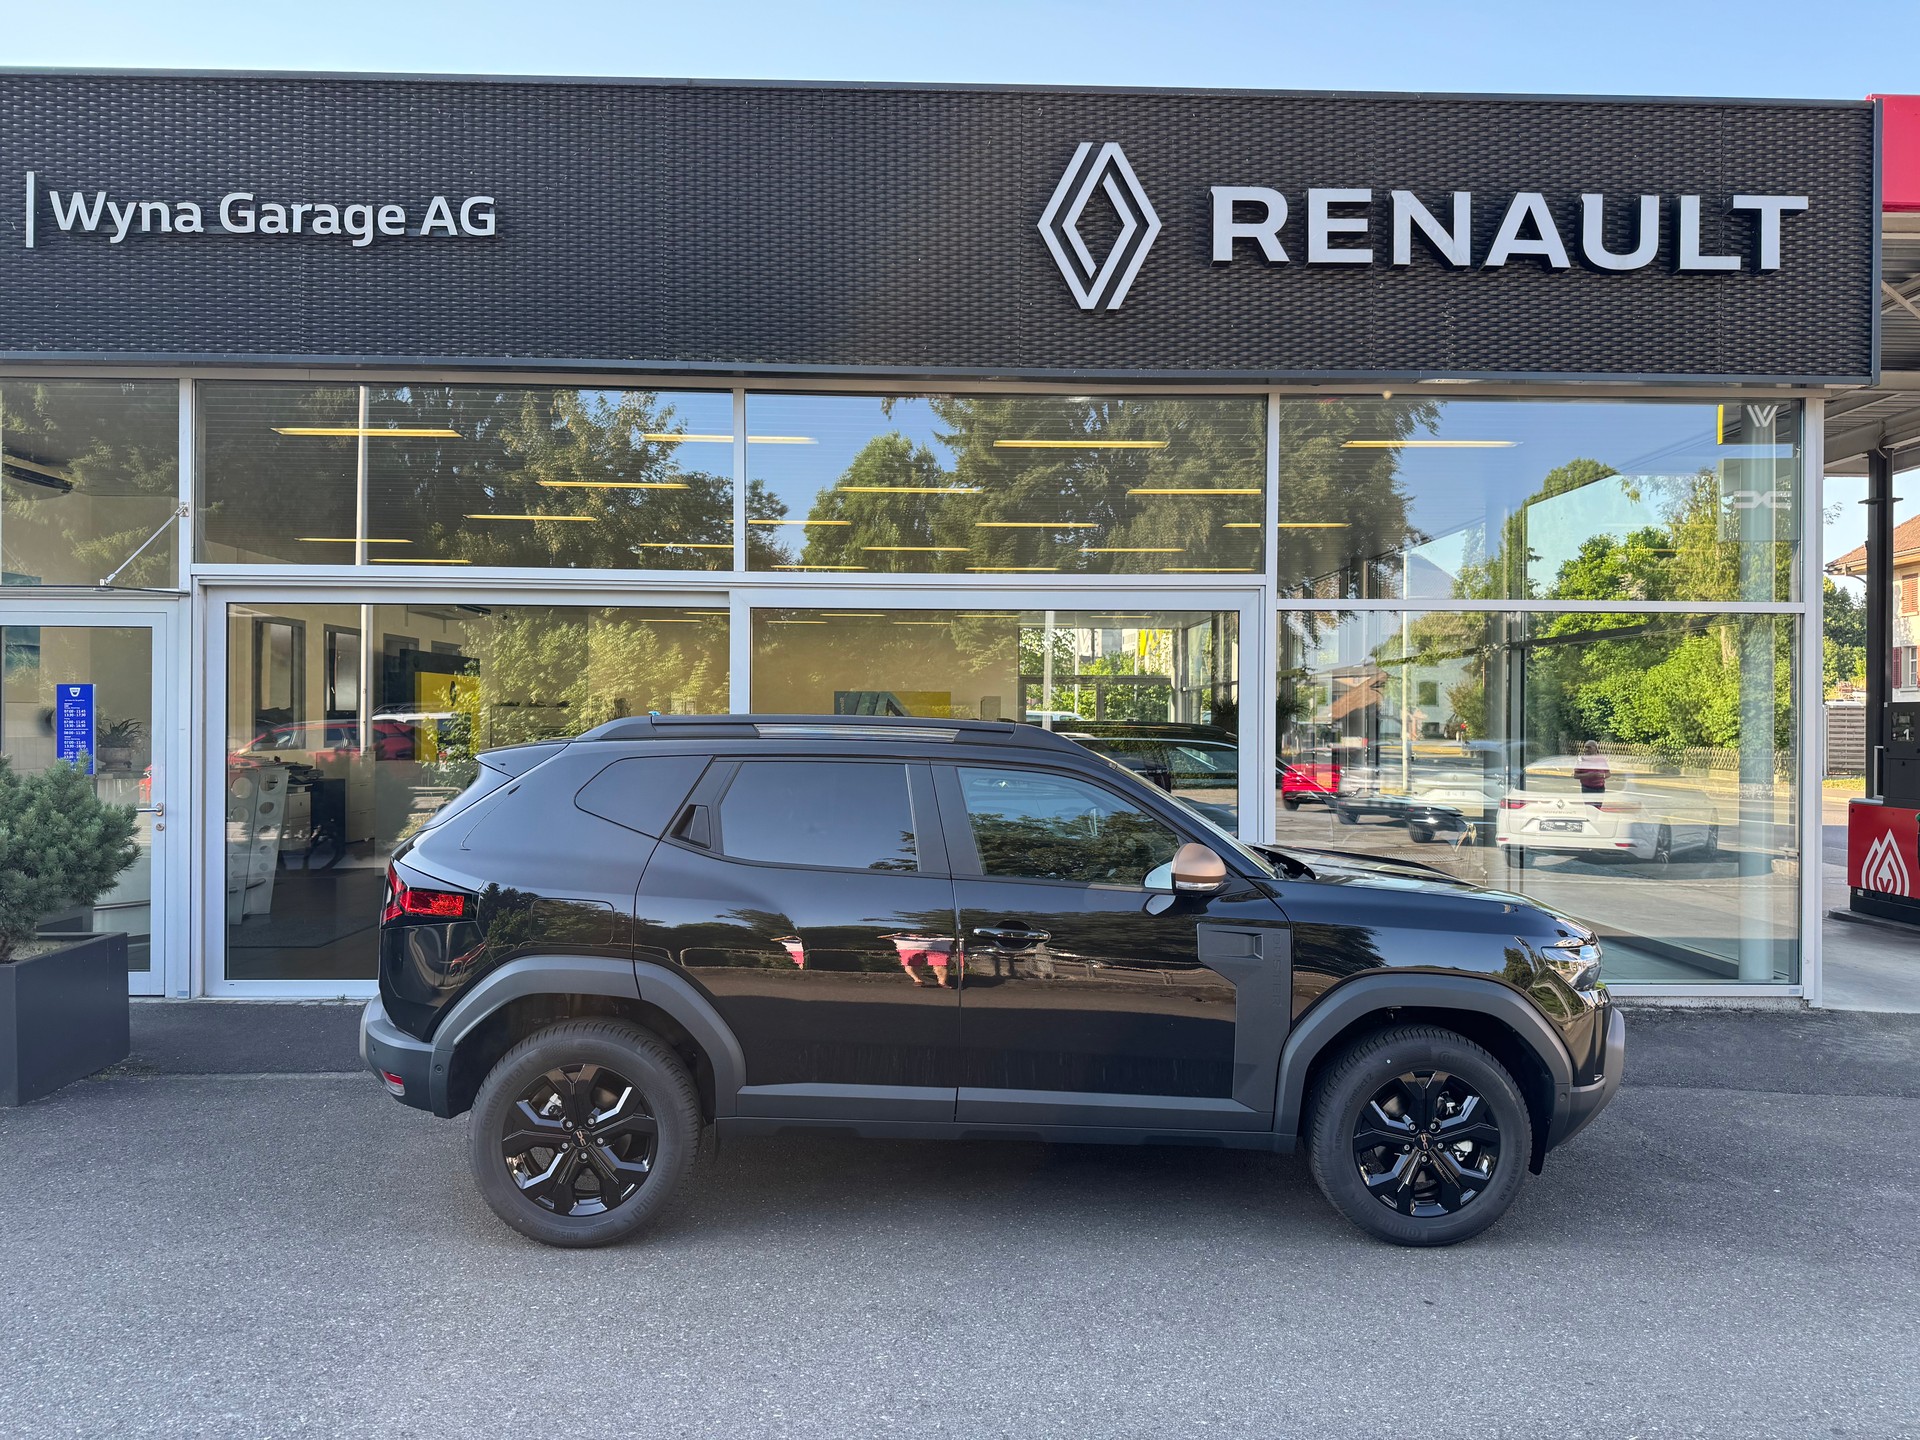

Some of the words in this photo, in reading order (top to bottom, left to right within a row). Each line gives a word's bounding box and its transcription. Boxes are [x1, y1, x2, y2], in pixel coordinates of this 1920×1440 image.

[50, 190, 204, 243] Wyna
[219, 192, 406, 247] Garage
[420, 195, 496, 237] AG
[1211, 186, 1809, 271] RENAULT
[1903, 729, 1910, 741] 1
[1271, 933, 1282, 1008] DUSTER
